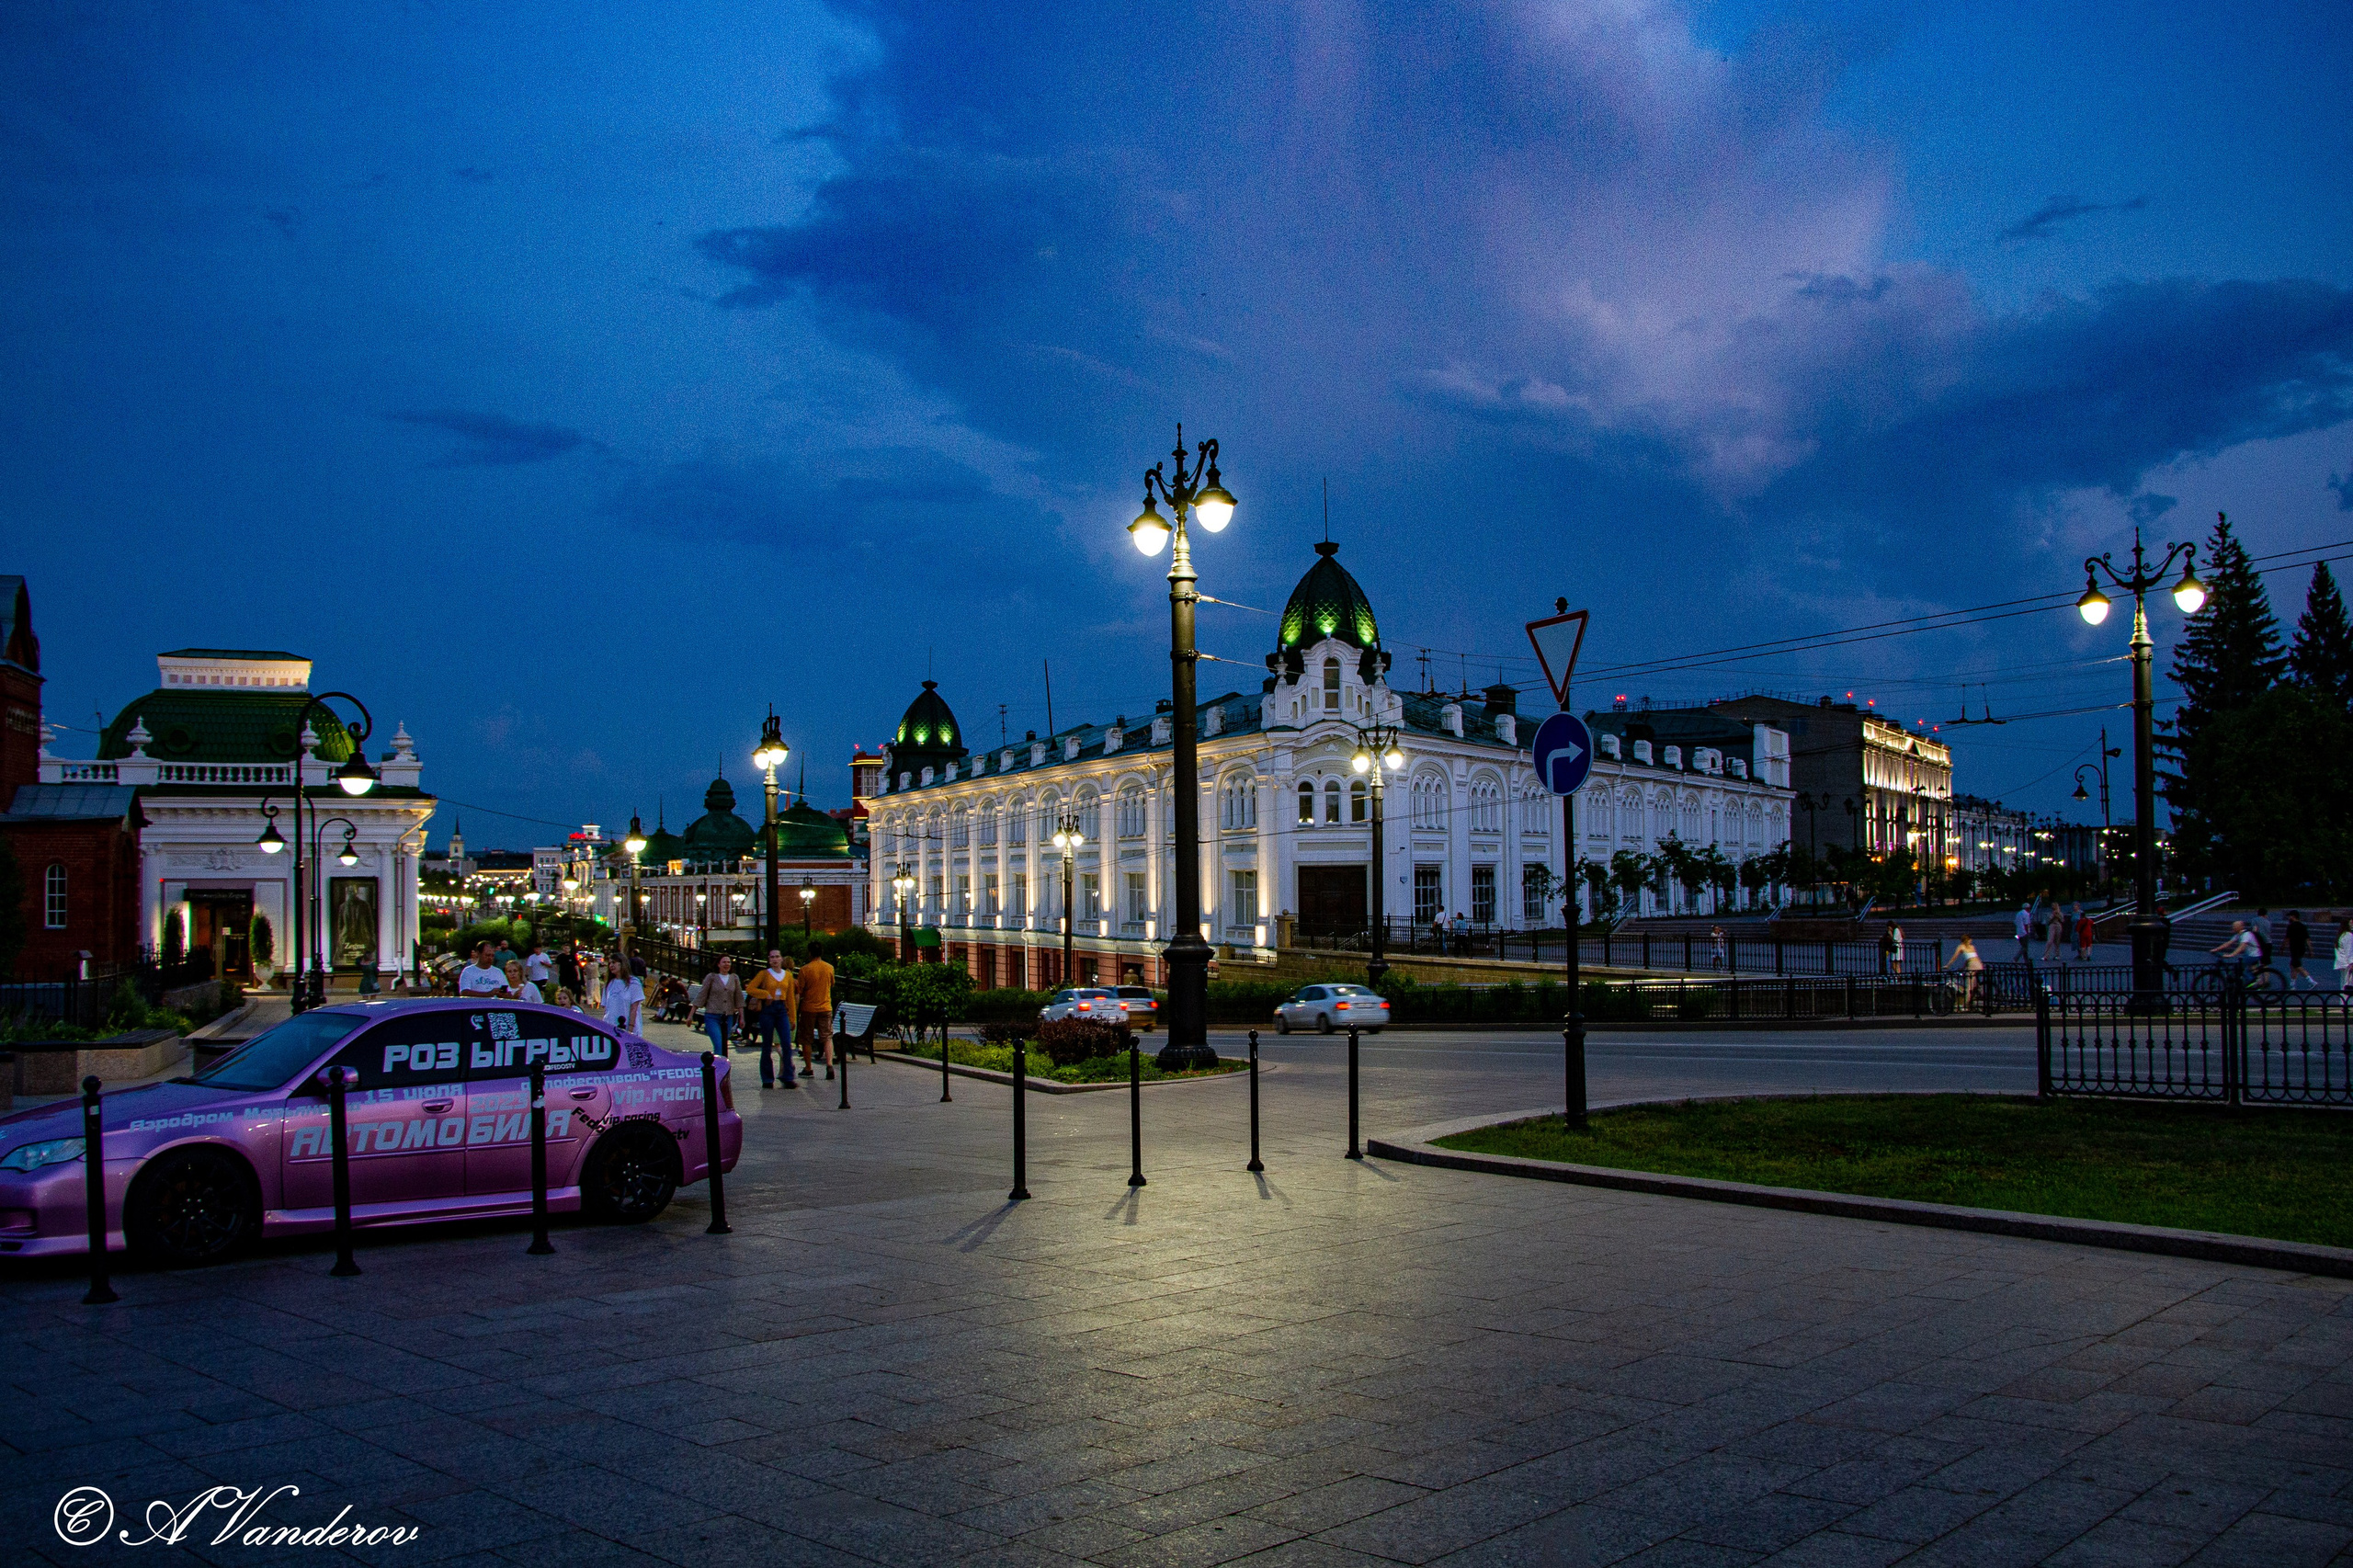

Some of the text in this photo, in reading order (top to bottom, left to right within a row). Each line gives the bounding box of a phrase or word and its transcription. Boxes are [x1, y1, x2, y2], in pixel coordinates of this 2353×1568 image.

[383, 1035, 611, 1073] РОЗ ЫГРЫШ
[551, 1062, 575, 1071] FEDOSTV
[364, 1088, 394, 1105] 15
[612, 1082, 705, 1108] vip.racin
[129, 1109, 233, 1133] Аэродром
